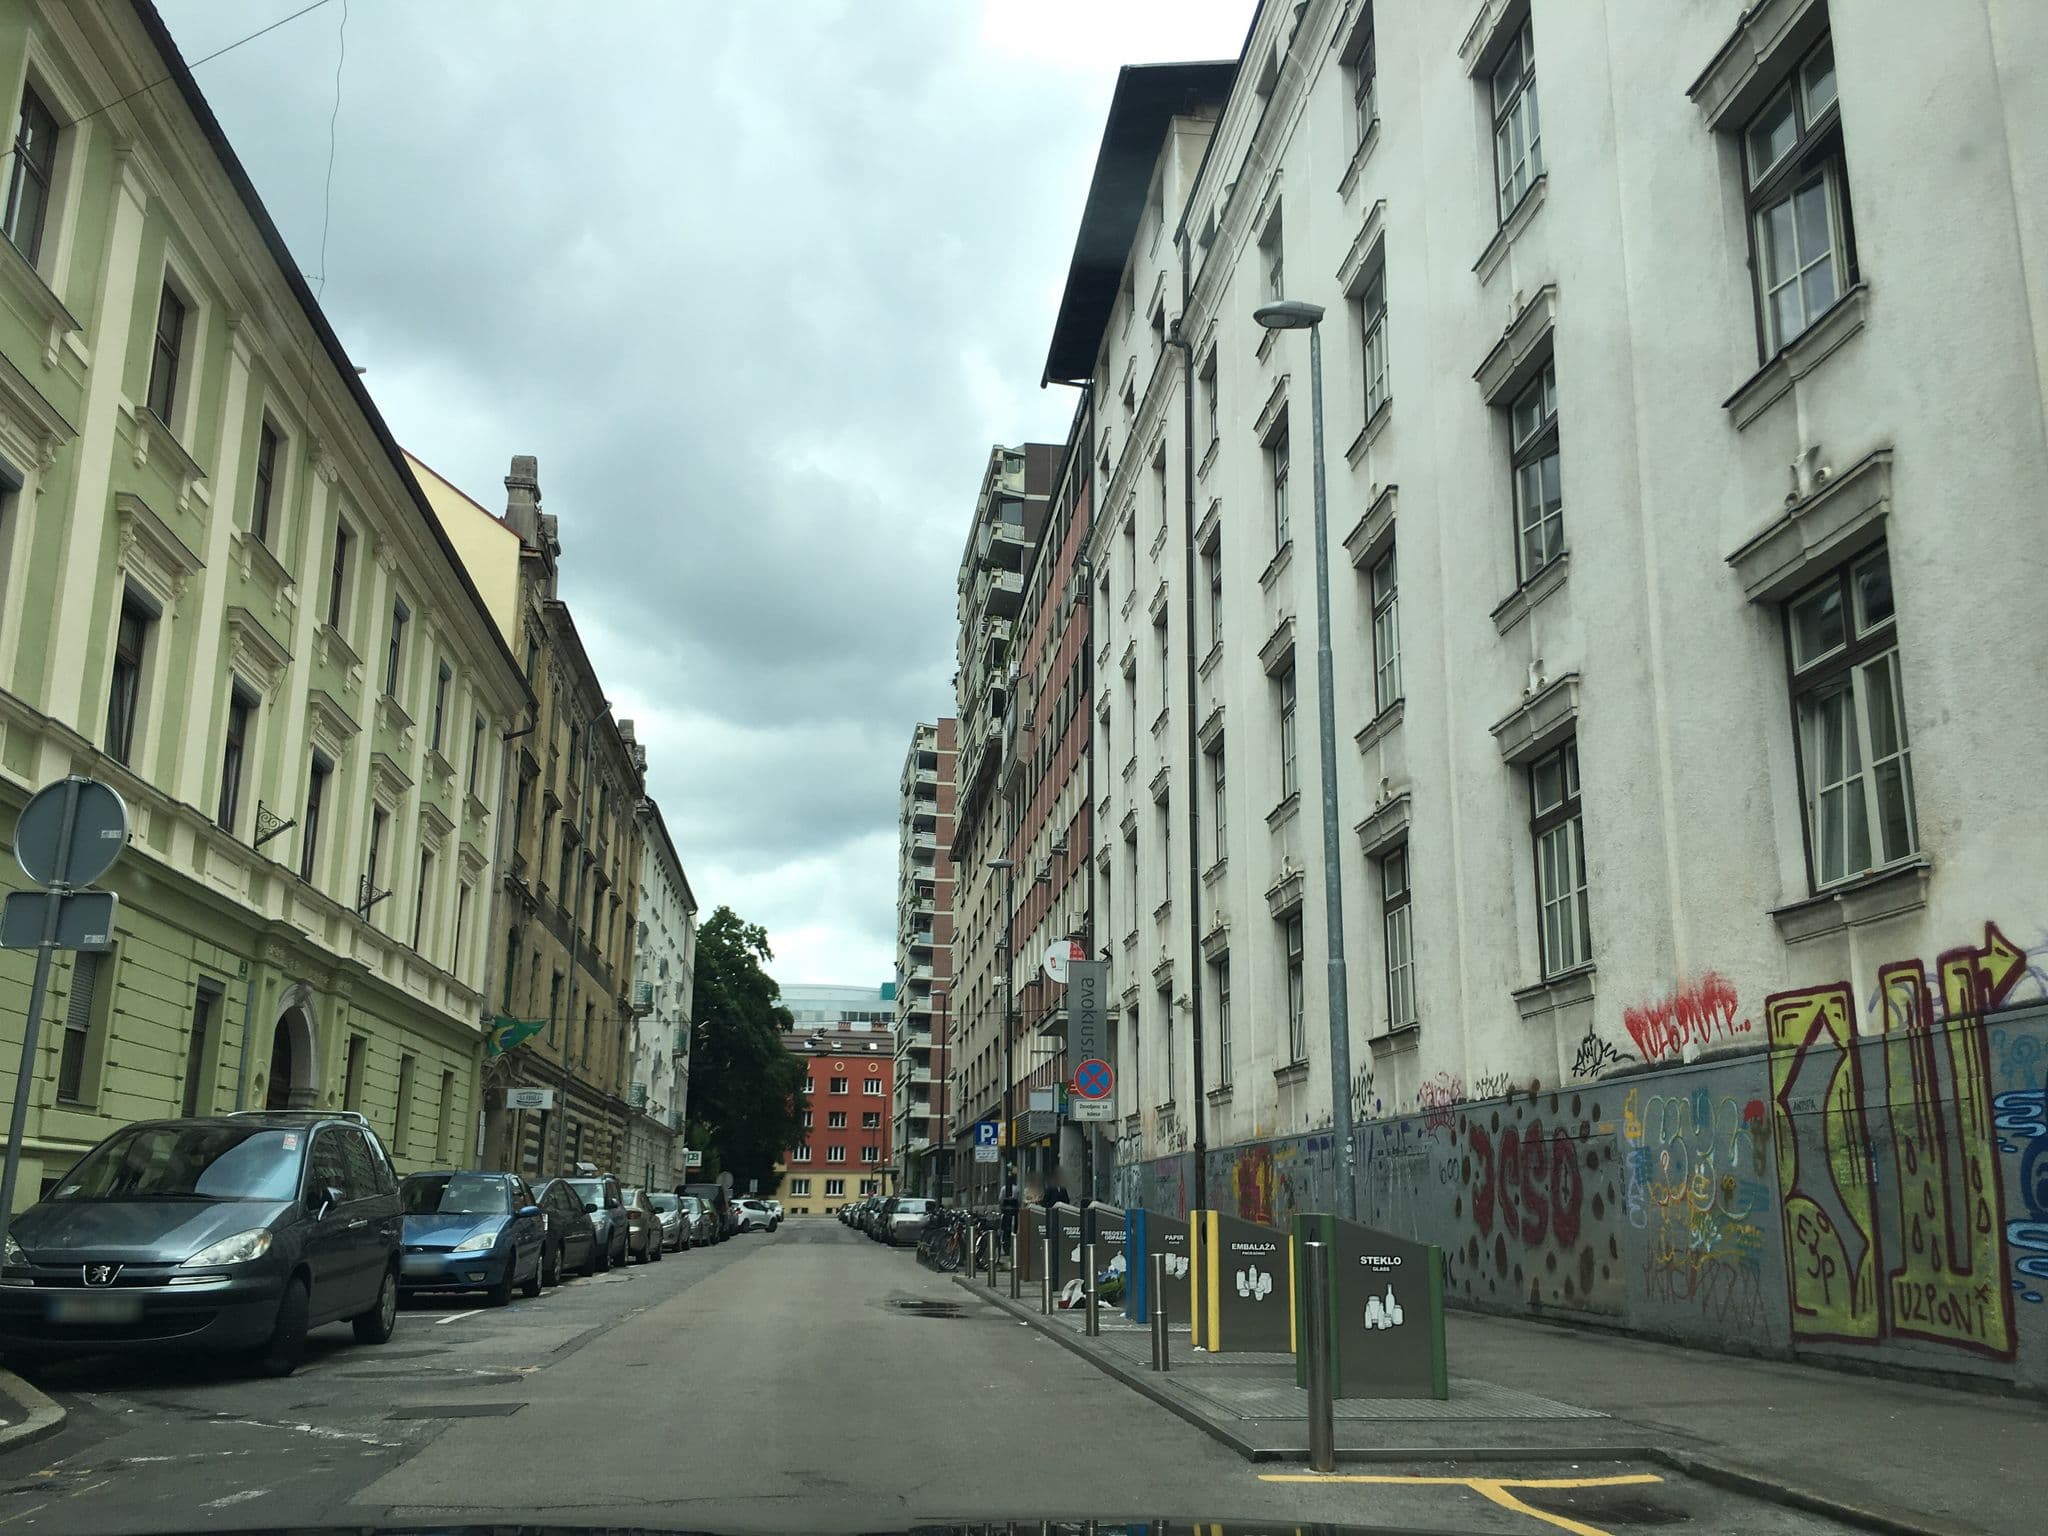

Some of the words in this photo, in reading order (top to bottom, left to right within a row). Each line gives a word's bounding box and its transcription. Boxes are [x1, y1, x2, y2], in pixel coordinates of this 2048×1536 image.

[1080, 977, 1098, 1062] ersnikova
[980, 1124, 993, 1143] P
[1231, 1242, 1276, 1251] EMBALAŽA
[1360, 1255, 1402, 1265] STEKLO
